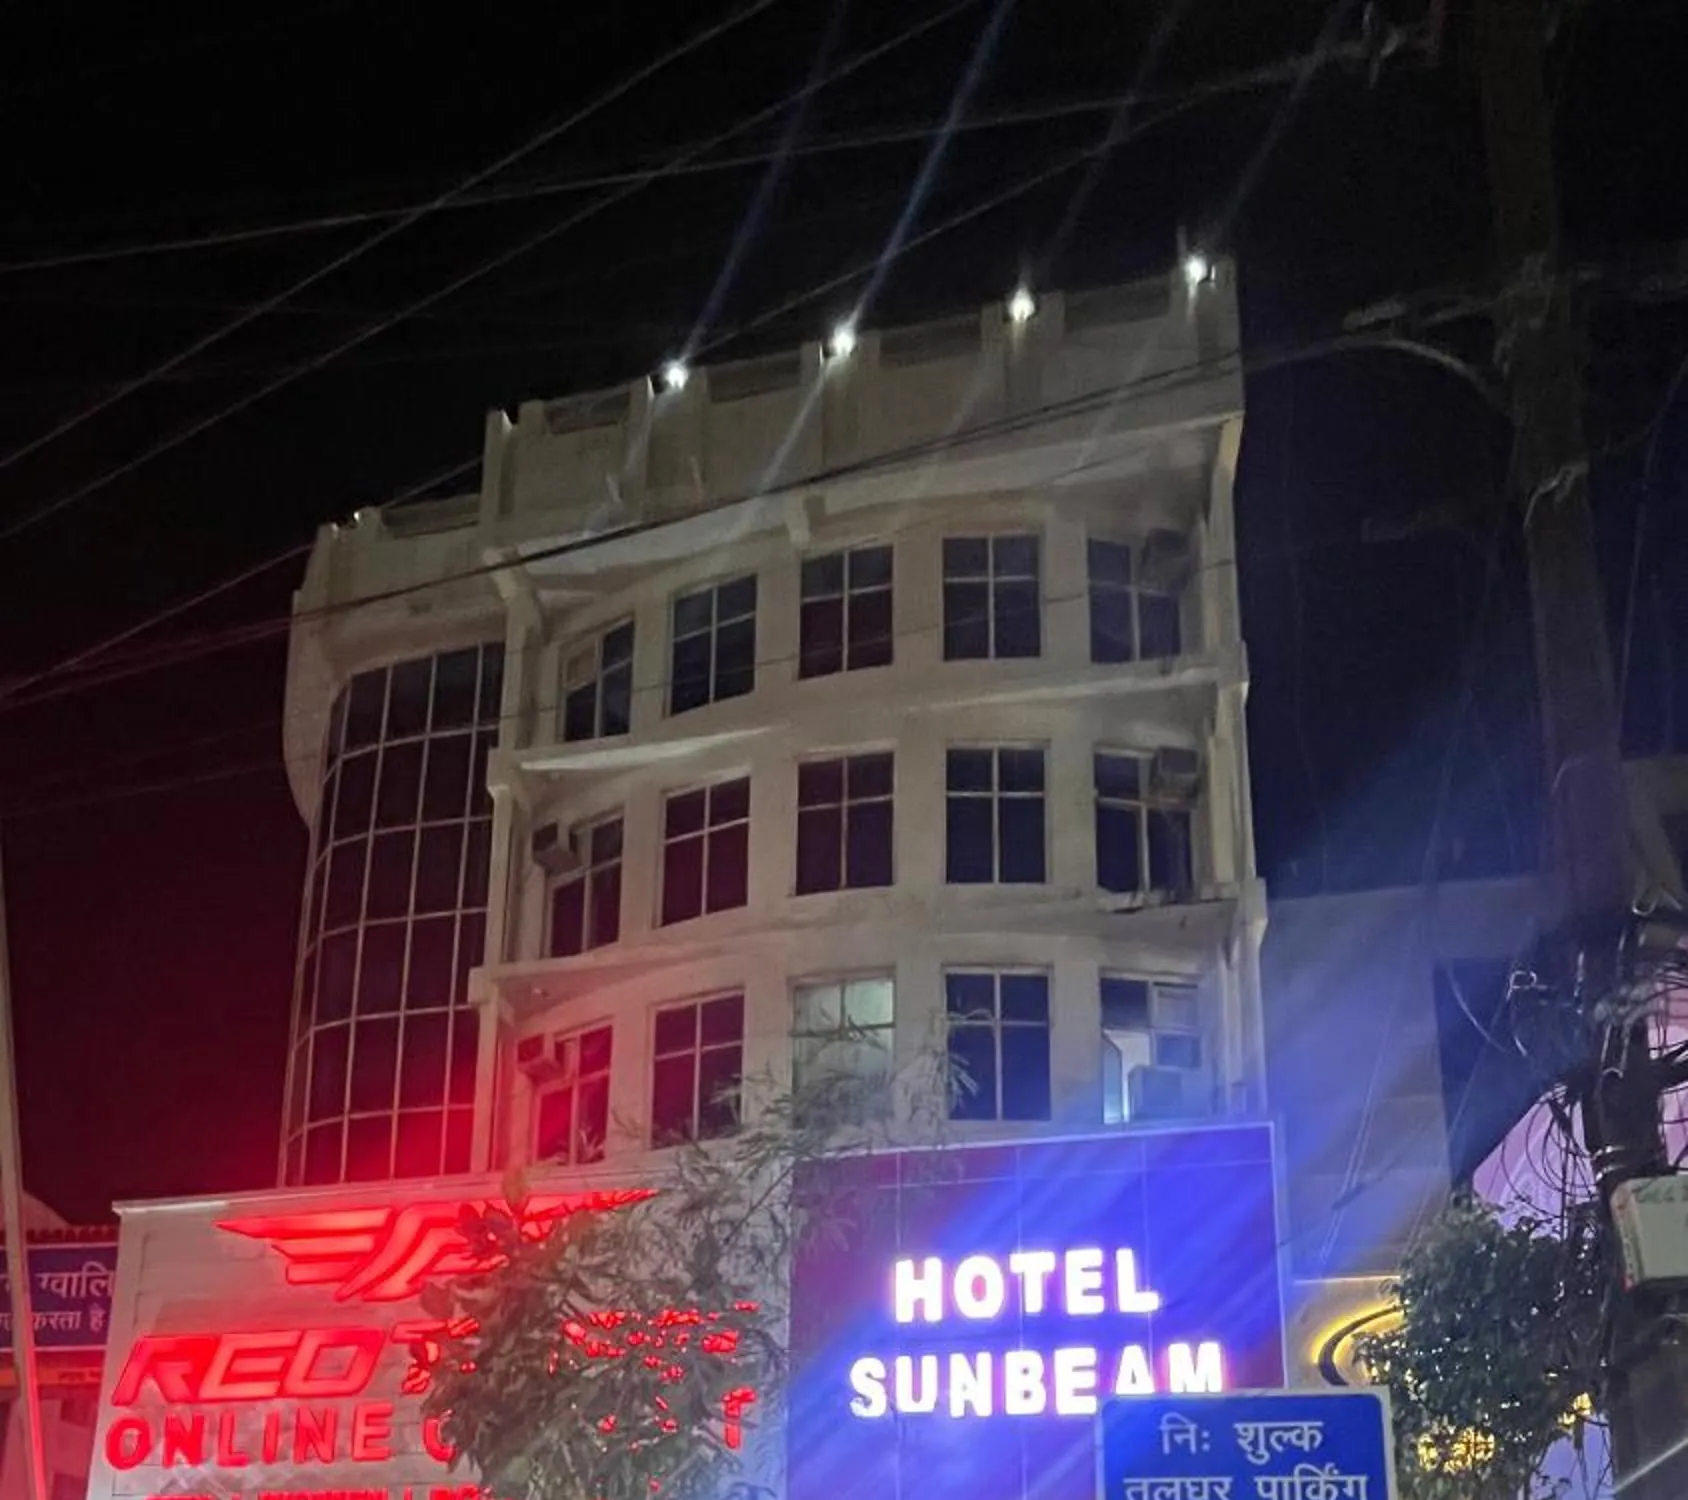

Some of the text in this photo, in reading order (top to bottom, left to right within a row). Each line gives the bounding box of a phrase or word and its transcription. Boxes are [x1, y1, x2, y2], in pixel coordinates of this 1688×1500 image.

[894, 1247, 1160, 1324] HOTEL
[850, 1340, 1224, 1419] SUNBEAM
[105, 1402, 396, 1471] ONLINE
[1233, 1420, 1324, 1465] शुल्क
